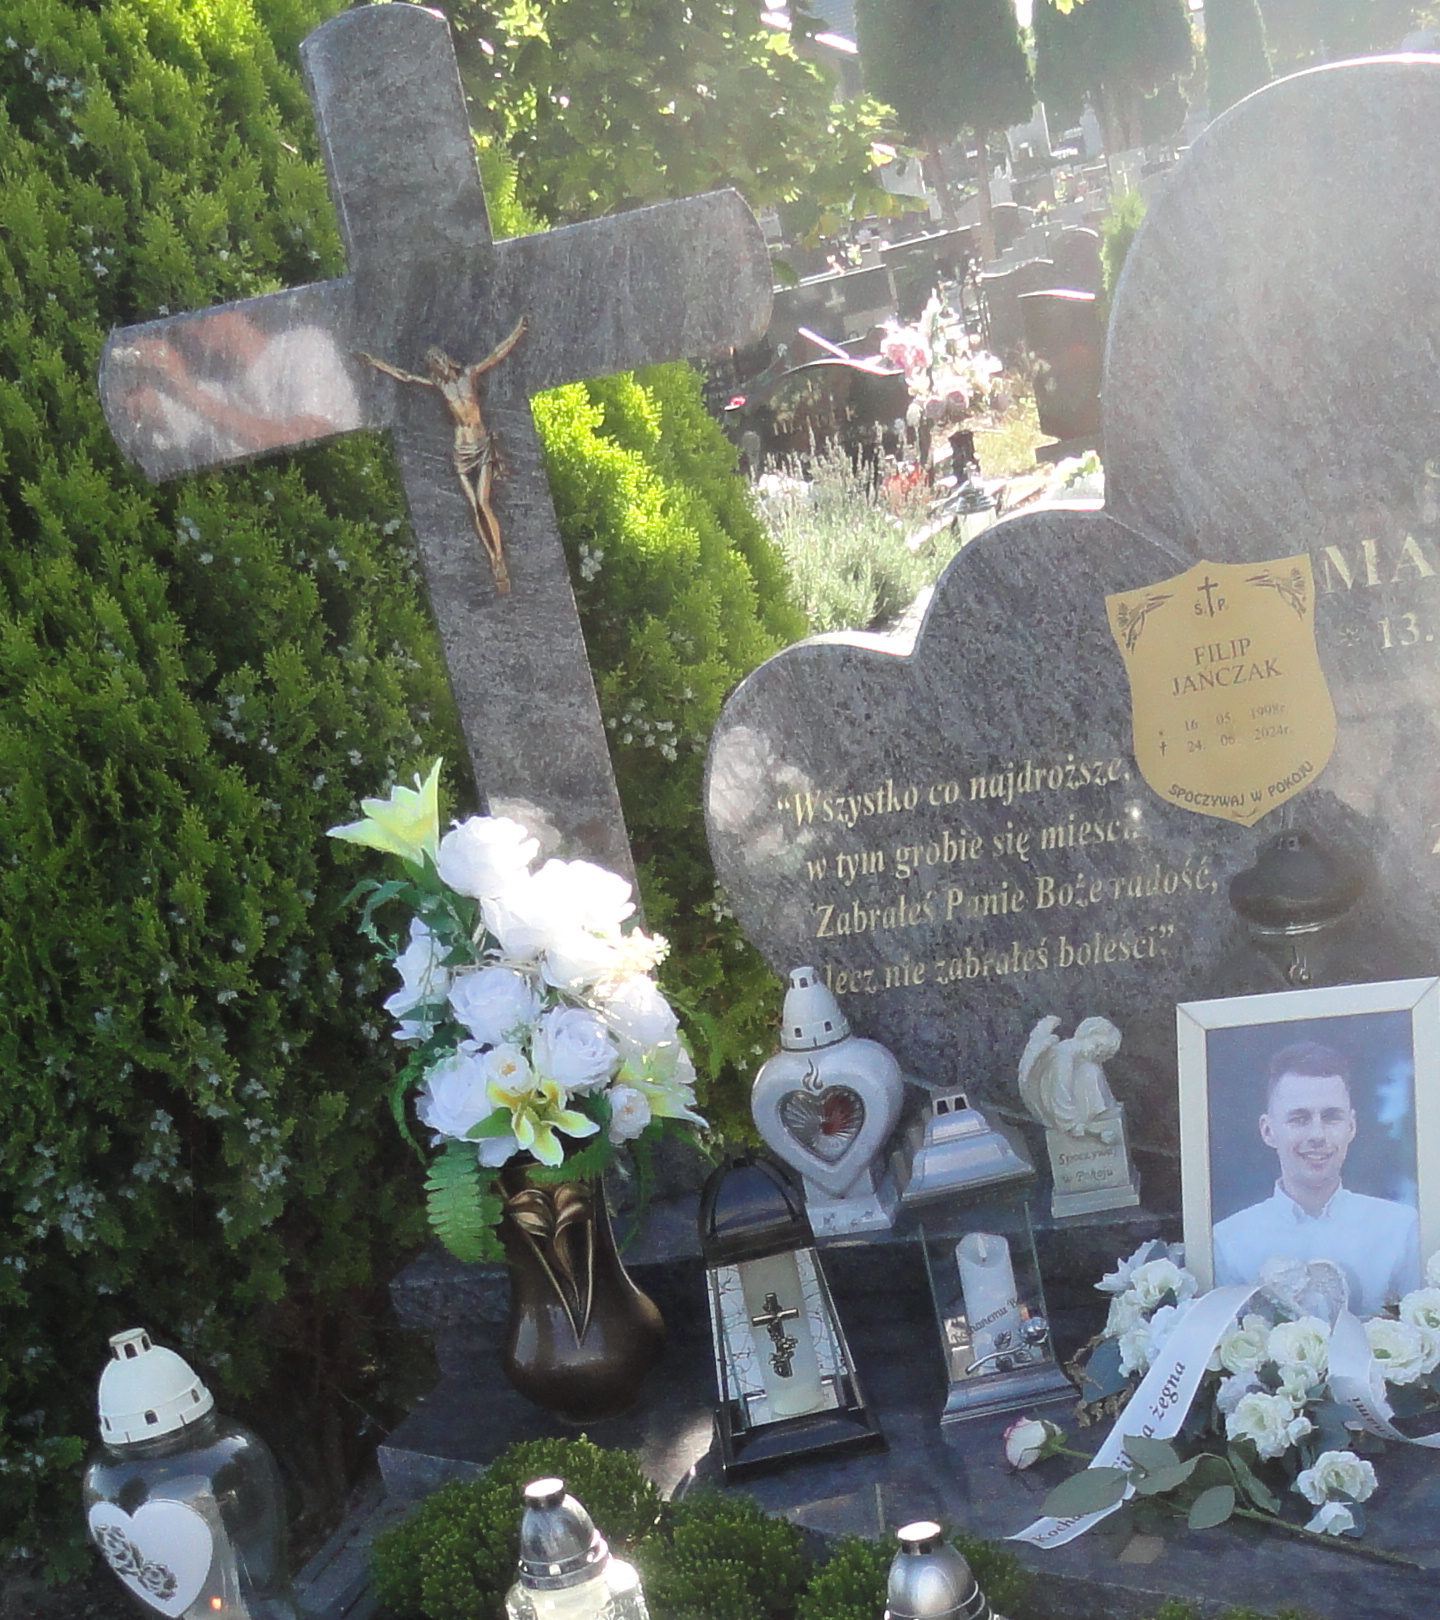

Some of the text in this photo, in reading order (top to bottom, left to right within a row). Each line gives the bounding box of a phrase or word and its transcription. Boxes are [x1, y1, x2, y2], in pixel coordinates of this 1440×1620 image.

[1193, 636, 1252, 667] FILIP
[1171, 656, 1283, 697] JAŃCZAK
[928, 781, 960, 807] co
[1168, 760, 1315, 808] SPOCZYWAJ W POKOJU
[806, 860, 828, 881] w
[835, 849, 886, 887] tym
[991, 821, 1031, 862] się
[1035, 872, 1104, 910] Boże
[824, 963, 878, 995] lecz
[884, 953, 927, 989] nie
[1148, 1360, 1187, 1423] żegna
